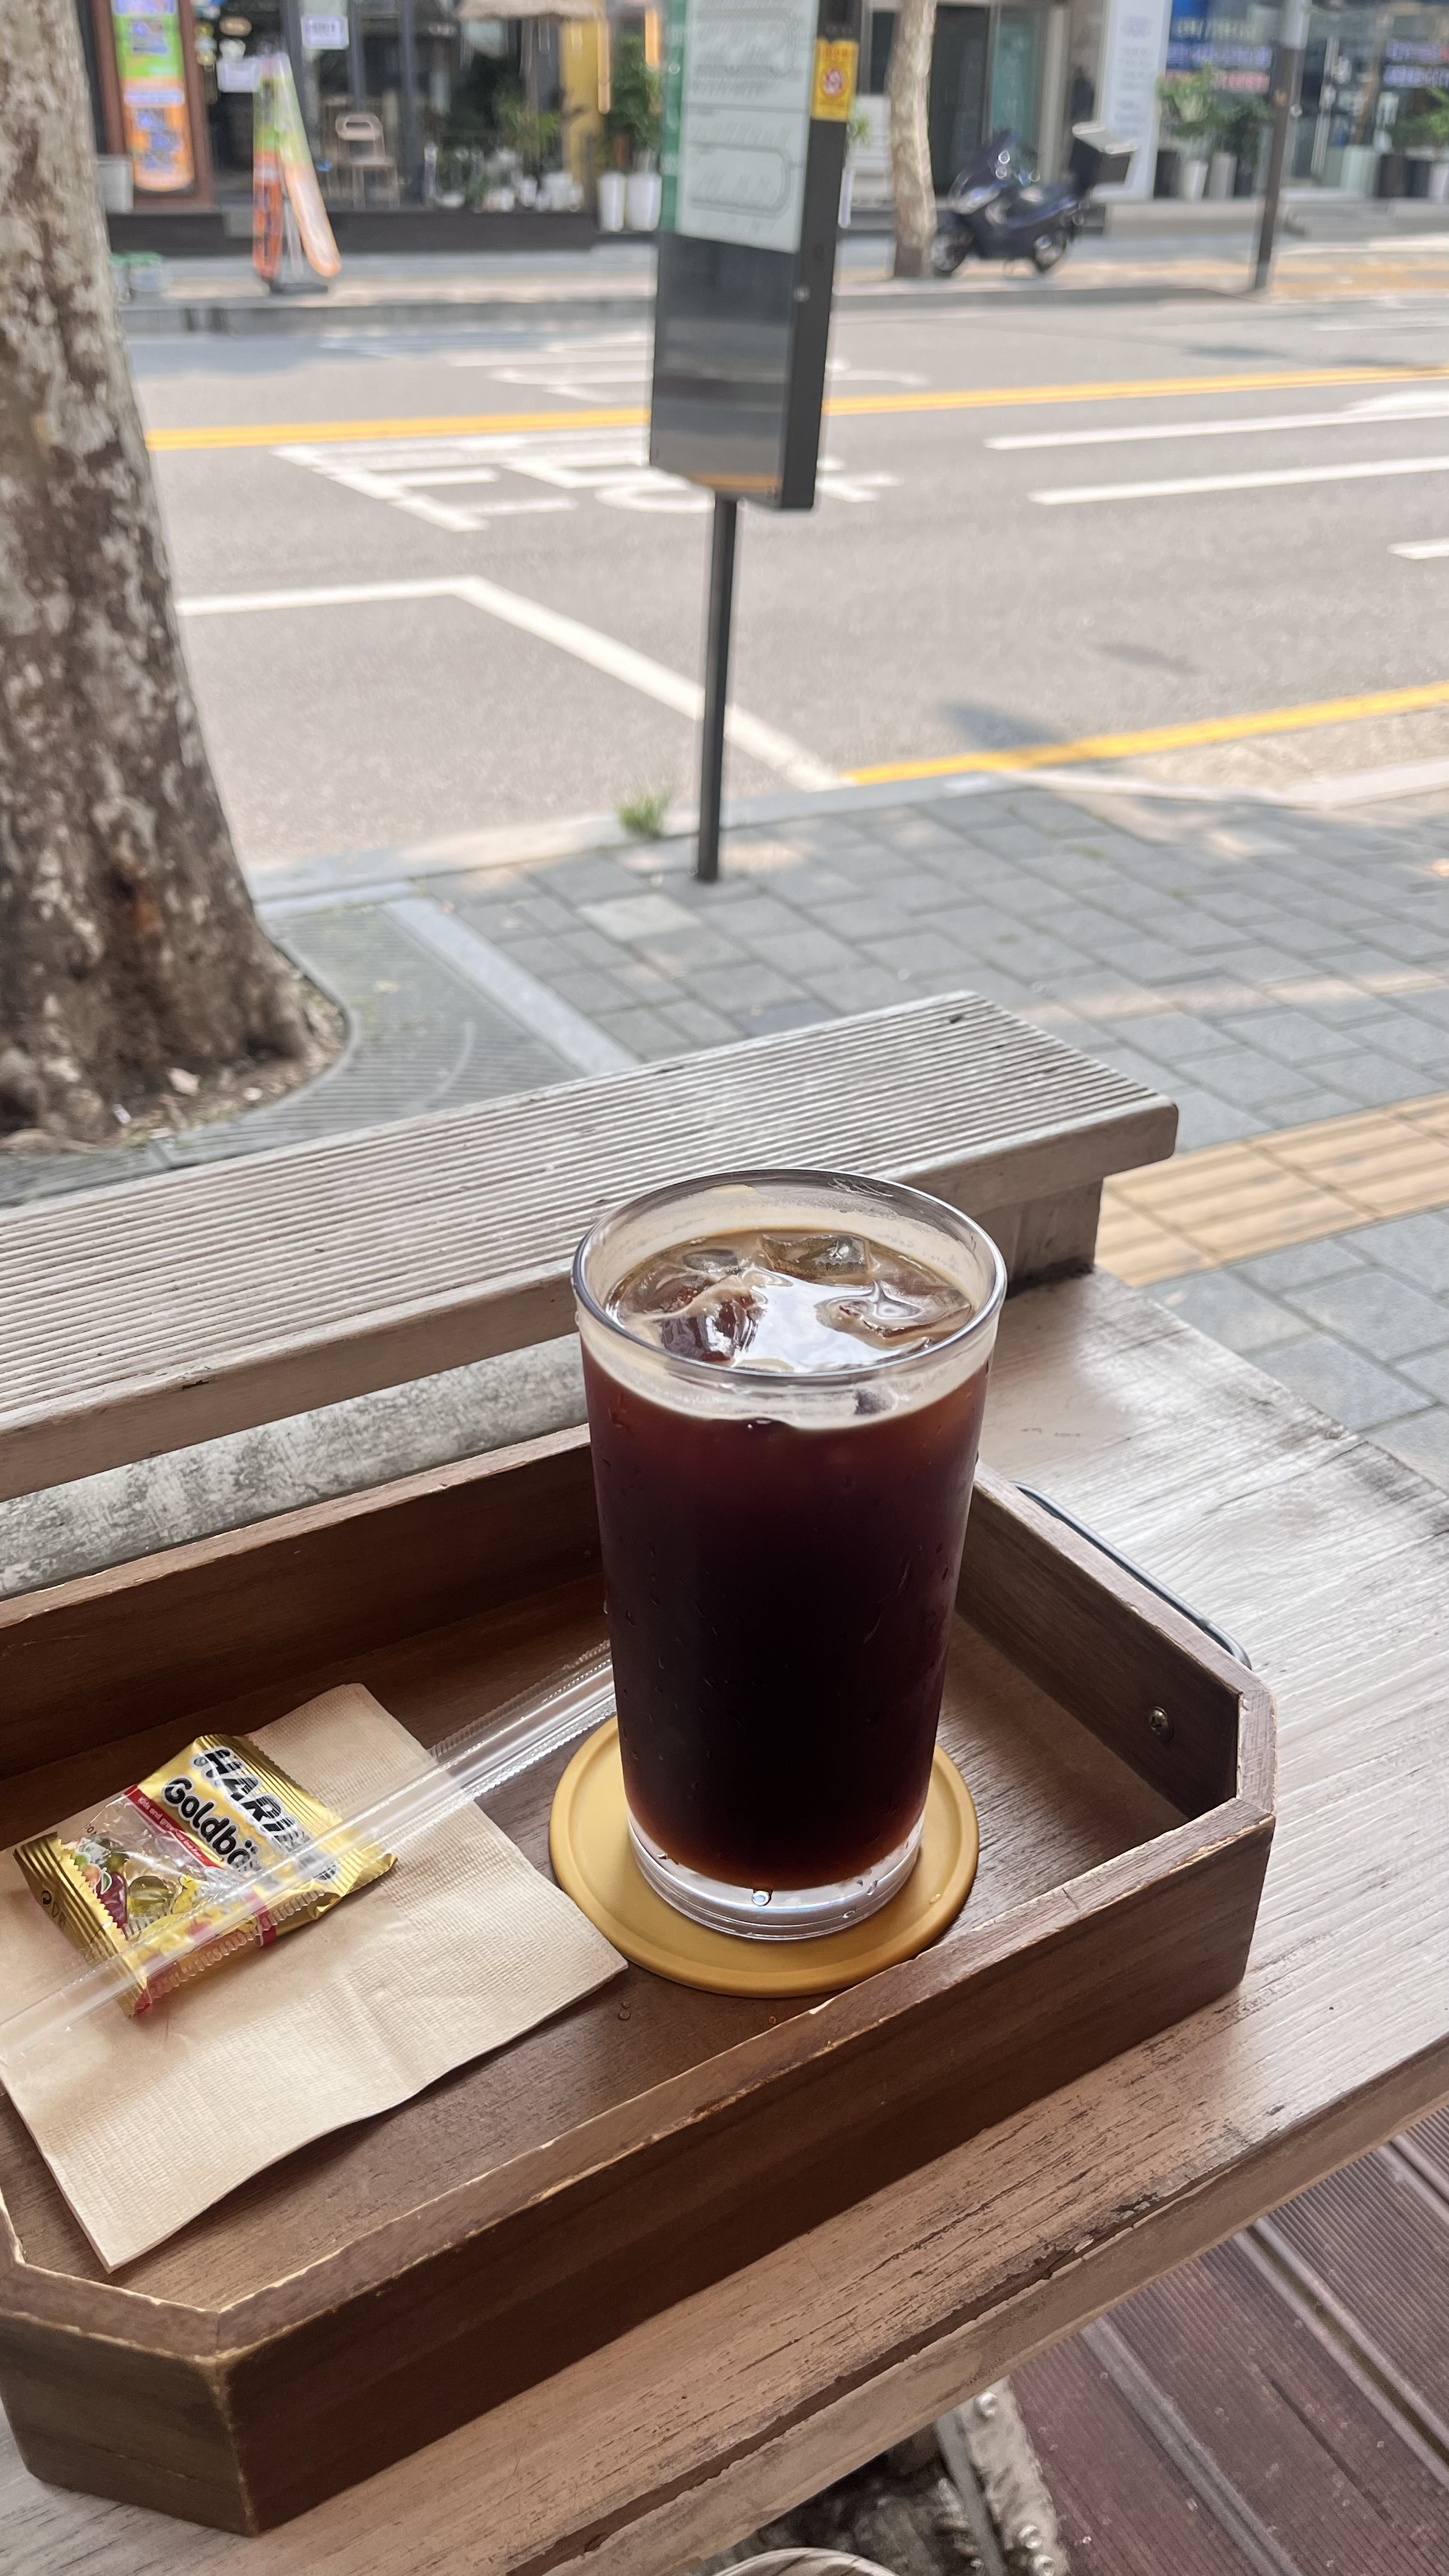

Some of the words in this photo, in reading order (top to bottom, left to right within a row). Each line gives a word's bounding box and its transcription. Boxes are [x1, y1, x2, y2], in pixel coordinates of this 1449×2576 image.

[138, 1796, 150, 1810] Kids
[149, 1808, 163, 1820] and
[164, 1777, 270, 1877] Goldbä
[194, 1749, 336, 1881] HARI
